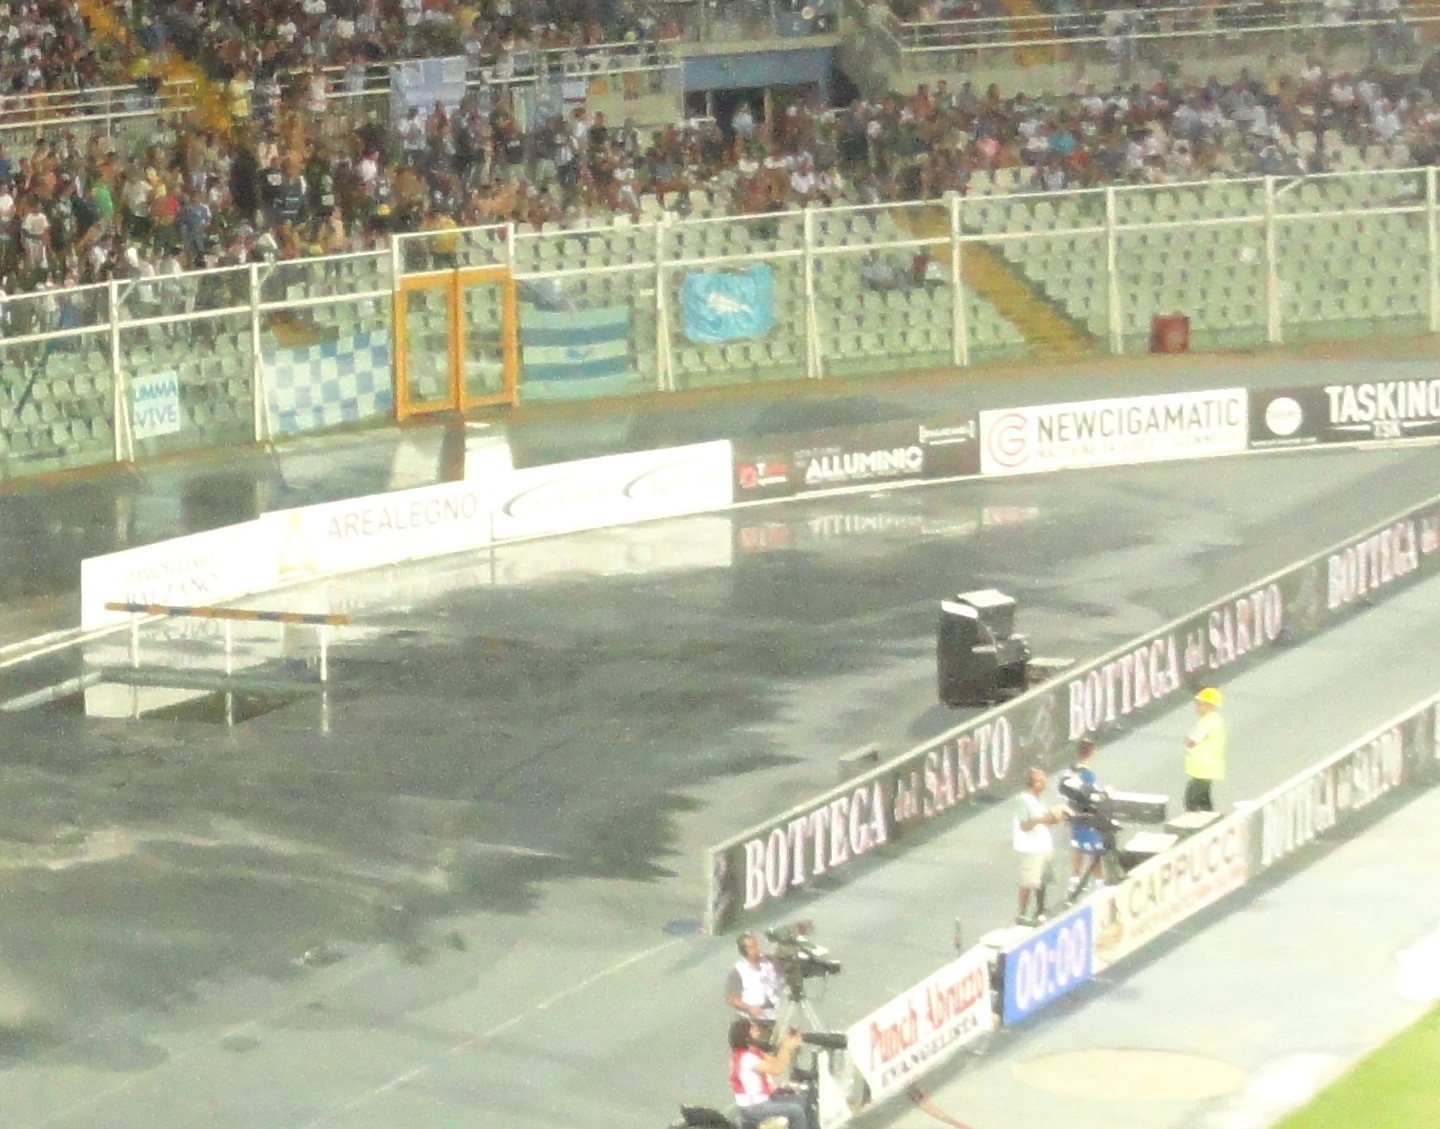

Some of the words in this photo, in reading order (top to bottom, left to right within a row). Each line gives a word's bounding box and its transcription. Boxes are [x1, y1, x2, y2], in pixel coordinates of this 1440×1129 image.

[1036, 398, 1240, 443] NEWCIGAMATIC
[806, 446, 923, 484] ALLUMINIO
[327, 492, 478, 541] AREALEGNO
[1327, 521, 1419, 609] BOTTEGA
[1069, 634, 1181, 741] BOTTEGA
[743, 781, 888, 910] BOTTEGA
[1015, 918, 1089, 1010] 00:00
